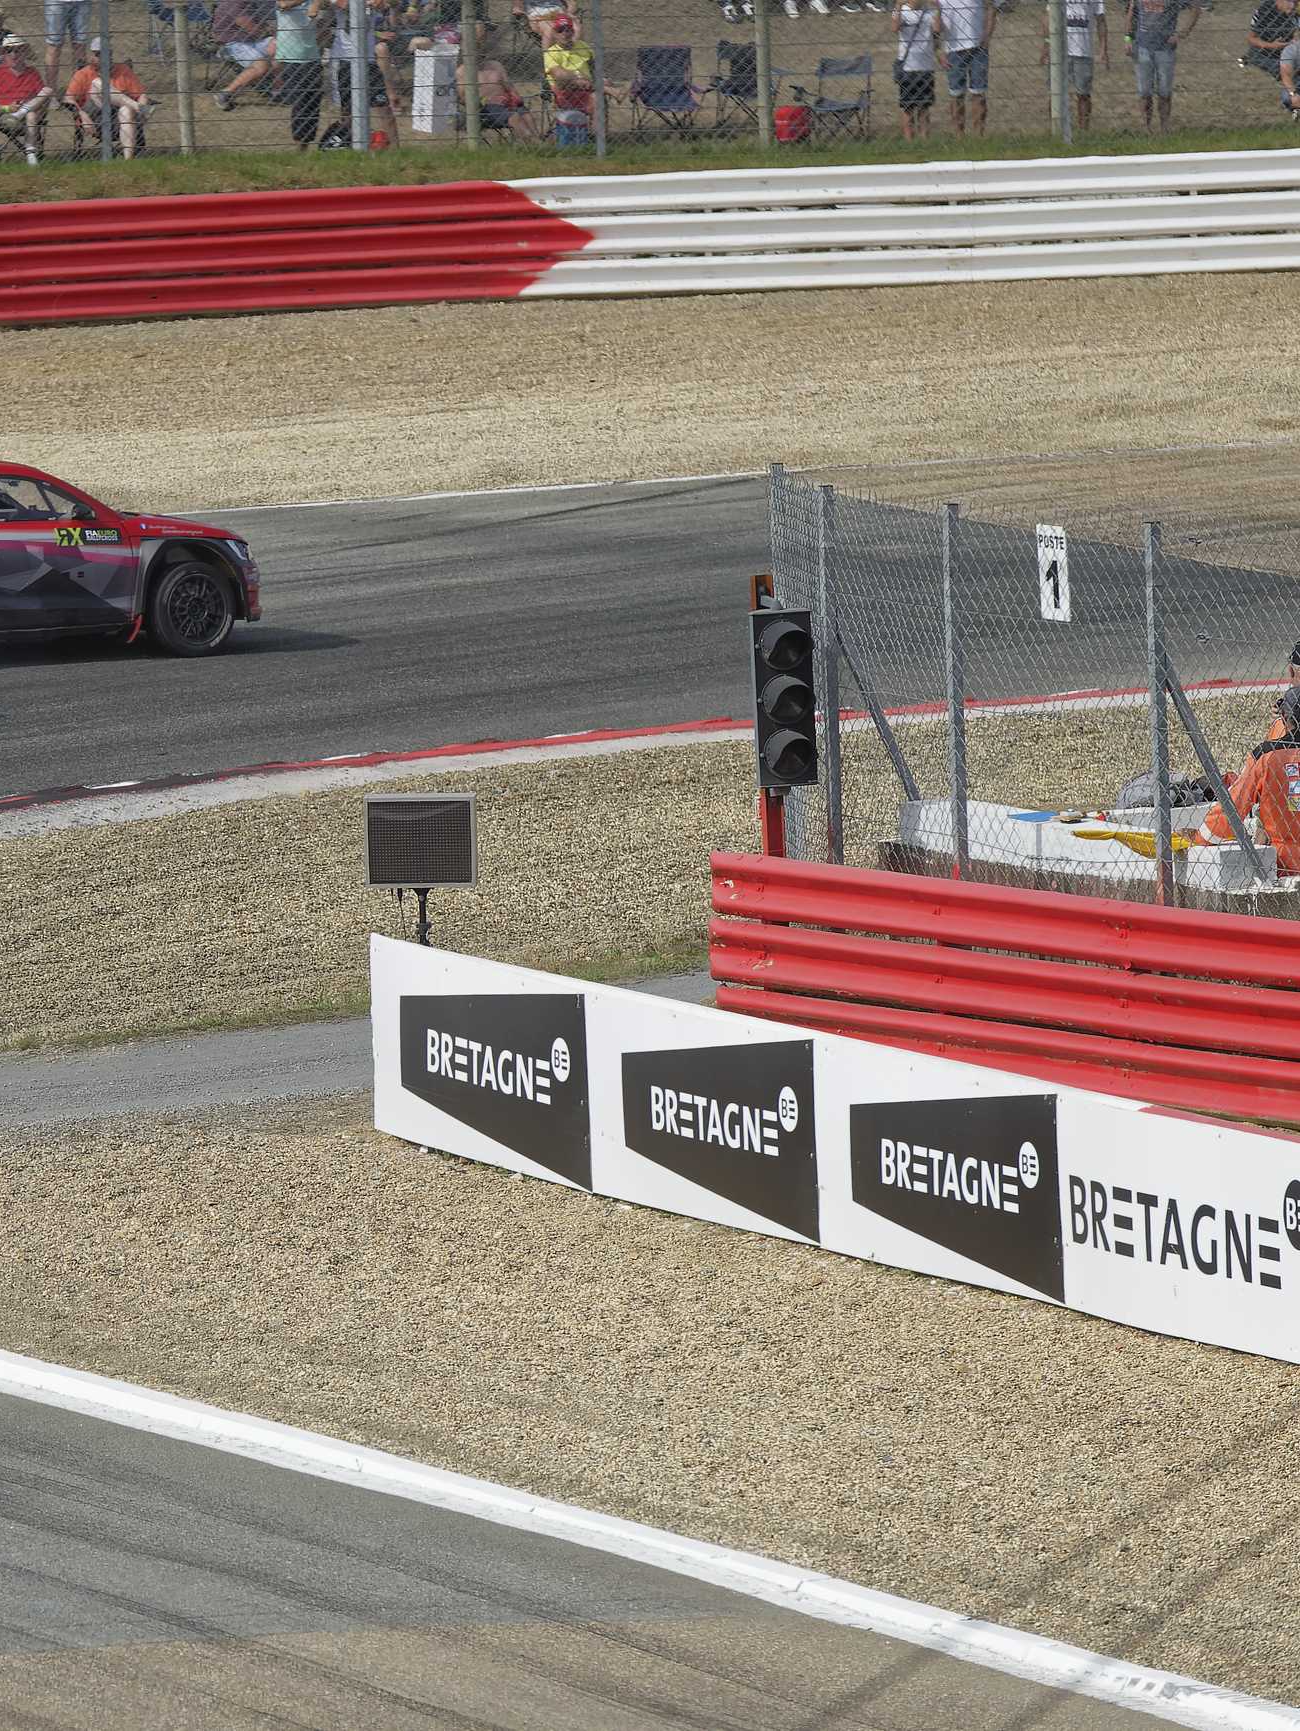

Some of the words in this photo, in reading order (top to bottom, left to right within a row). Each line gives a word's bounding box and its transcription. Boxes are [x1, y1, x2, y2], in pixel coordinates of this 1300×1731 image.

[1038, 534, 1065, 550] POSTE
[1045, 560, 1060, 609] 1
[427, 1028, 551, 1105] BRETAGNE
[650, 1085, 779, 1157] BRETAGNE
[881, 1138, 1019, 1214] BRETAGNE
[1069, 1174, 1282, 1290] BRETAGNE
